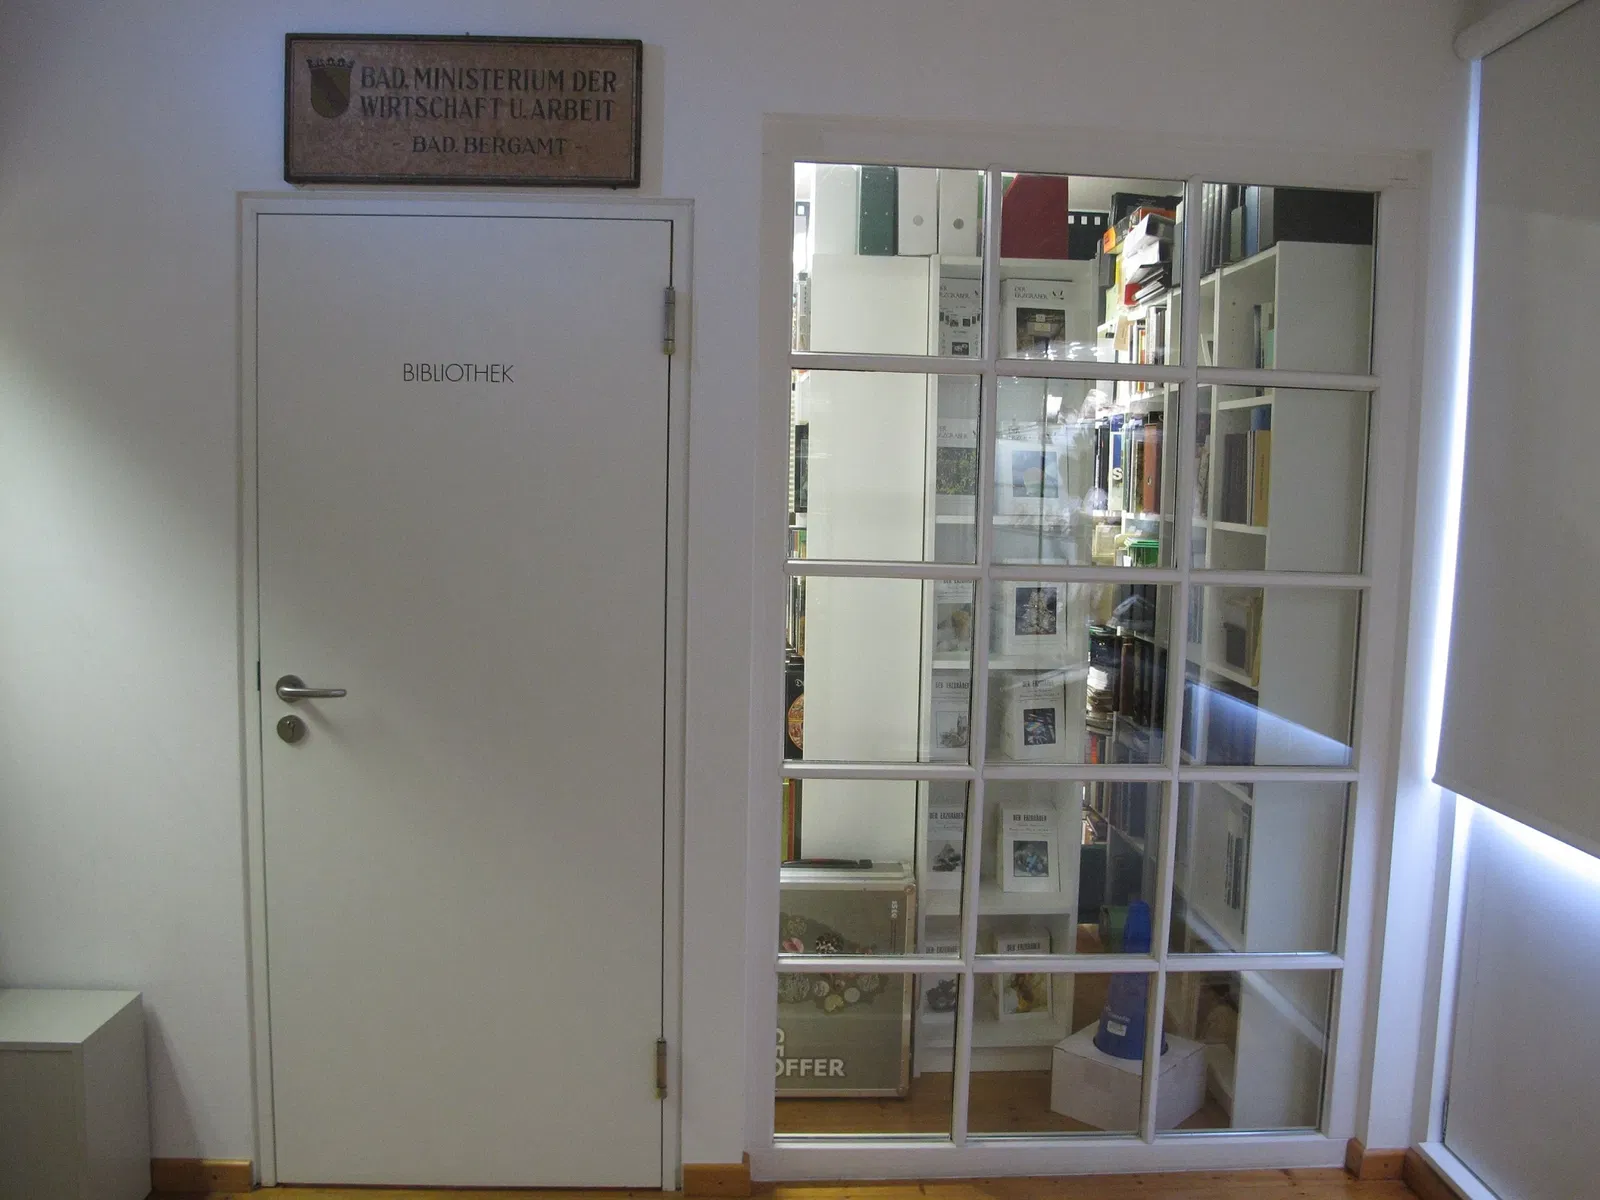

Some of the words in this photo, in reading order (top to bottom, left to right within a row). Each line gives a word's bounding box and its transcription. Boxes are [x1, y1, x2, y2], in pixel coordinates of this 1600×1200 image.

[361, 67, 409, 90] BAD.
[414, 68, 565, 92] MINISTERIUM
[572, 70, 617, 93] DER
[361, 96, 504, 120] WIRTSCHAFT
[510, 97, 527, 119] U.
[531, 98, 615, 122] ARBEIT
[412, 136, 458, 154] BAD.
[464, 137, 568, 156] BERGAMT
[403, 363, 514, 383] BIBLIOTHEK
